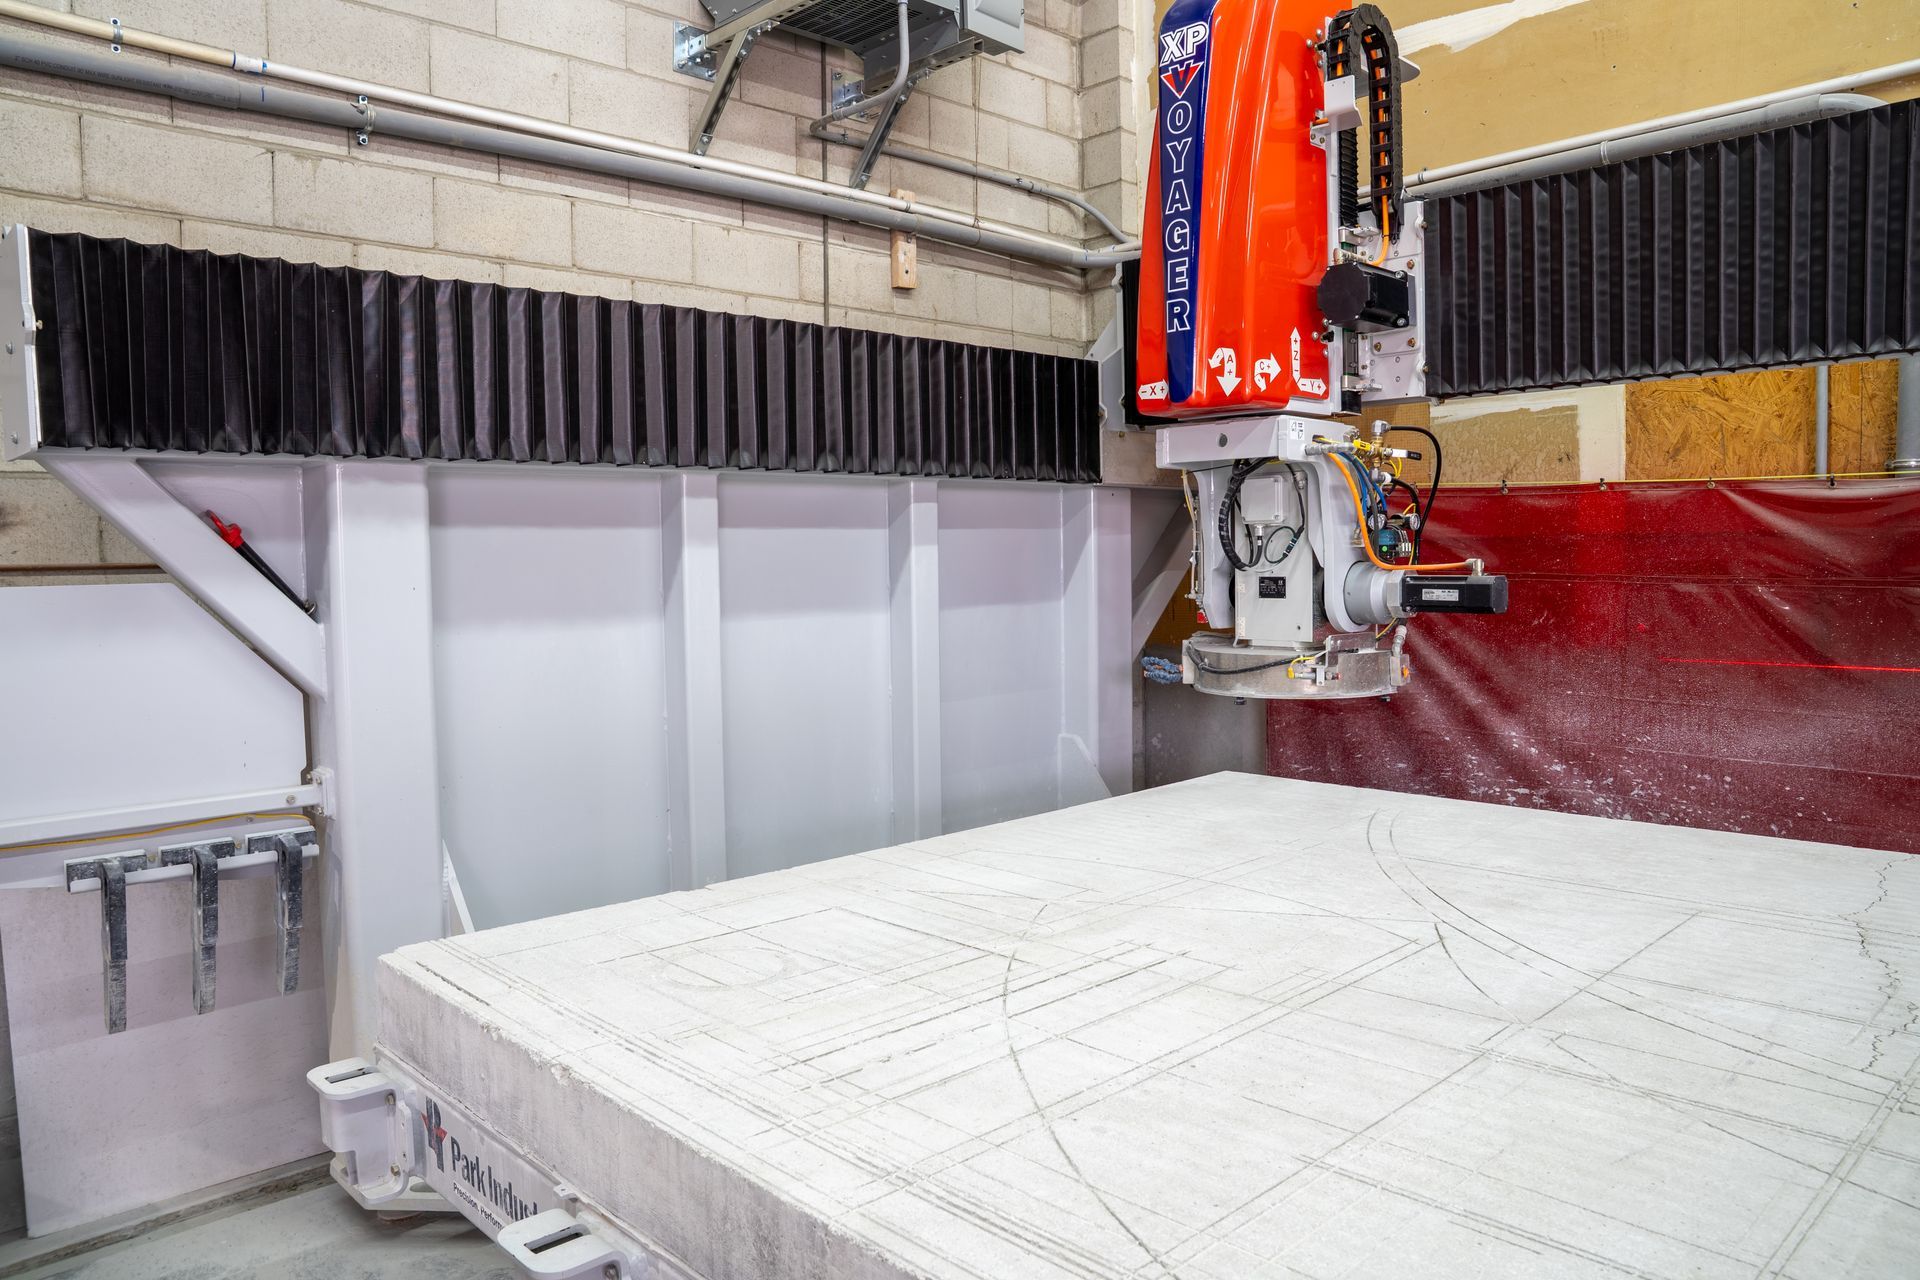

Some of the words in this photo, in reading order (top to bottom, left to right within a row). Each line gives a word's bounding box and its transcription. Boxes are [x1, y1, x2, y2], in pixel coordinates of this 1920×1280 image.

[1160, 22, 1209, 67] XP
[1166, 60, 1194, 333] VOYAGER
[450, 1136, 487, 1197] Park
[480, 1206, 505, 1231] Perform
